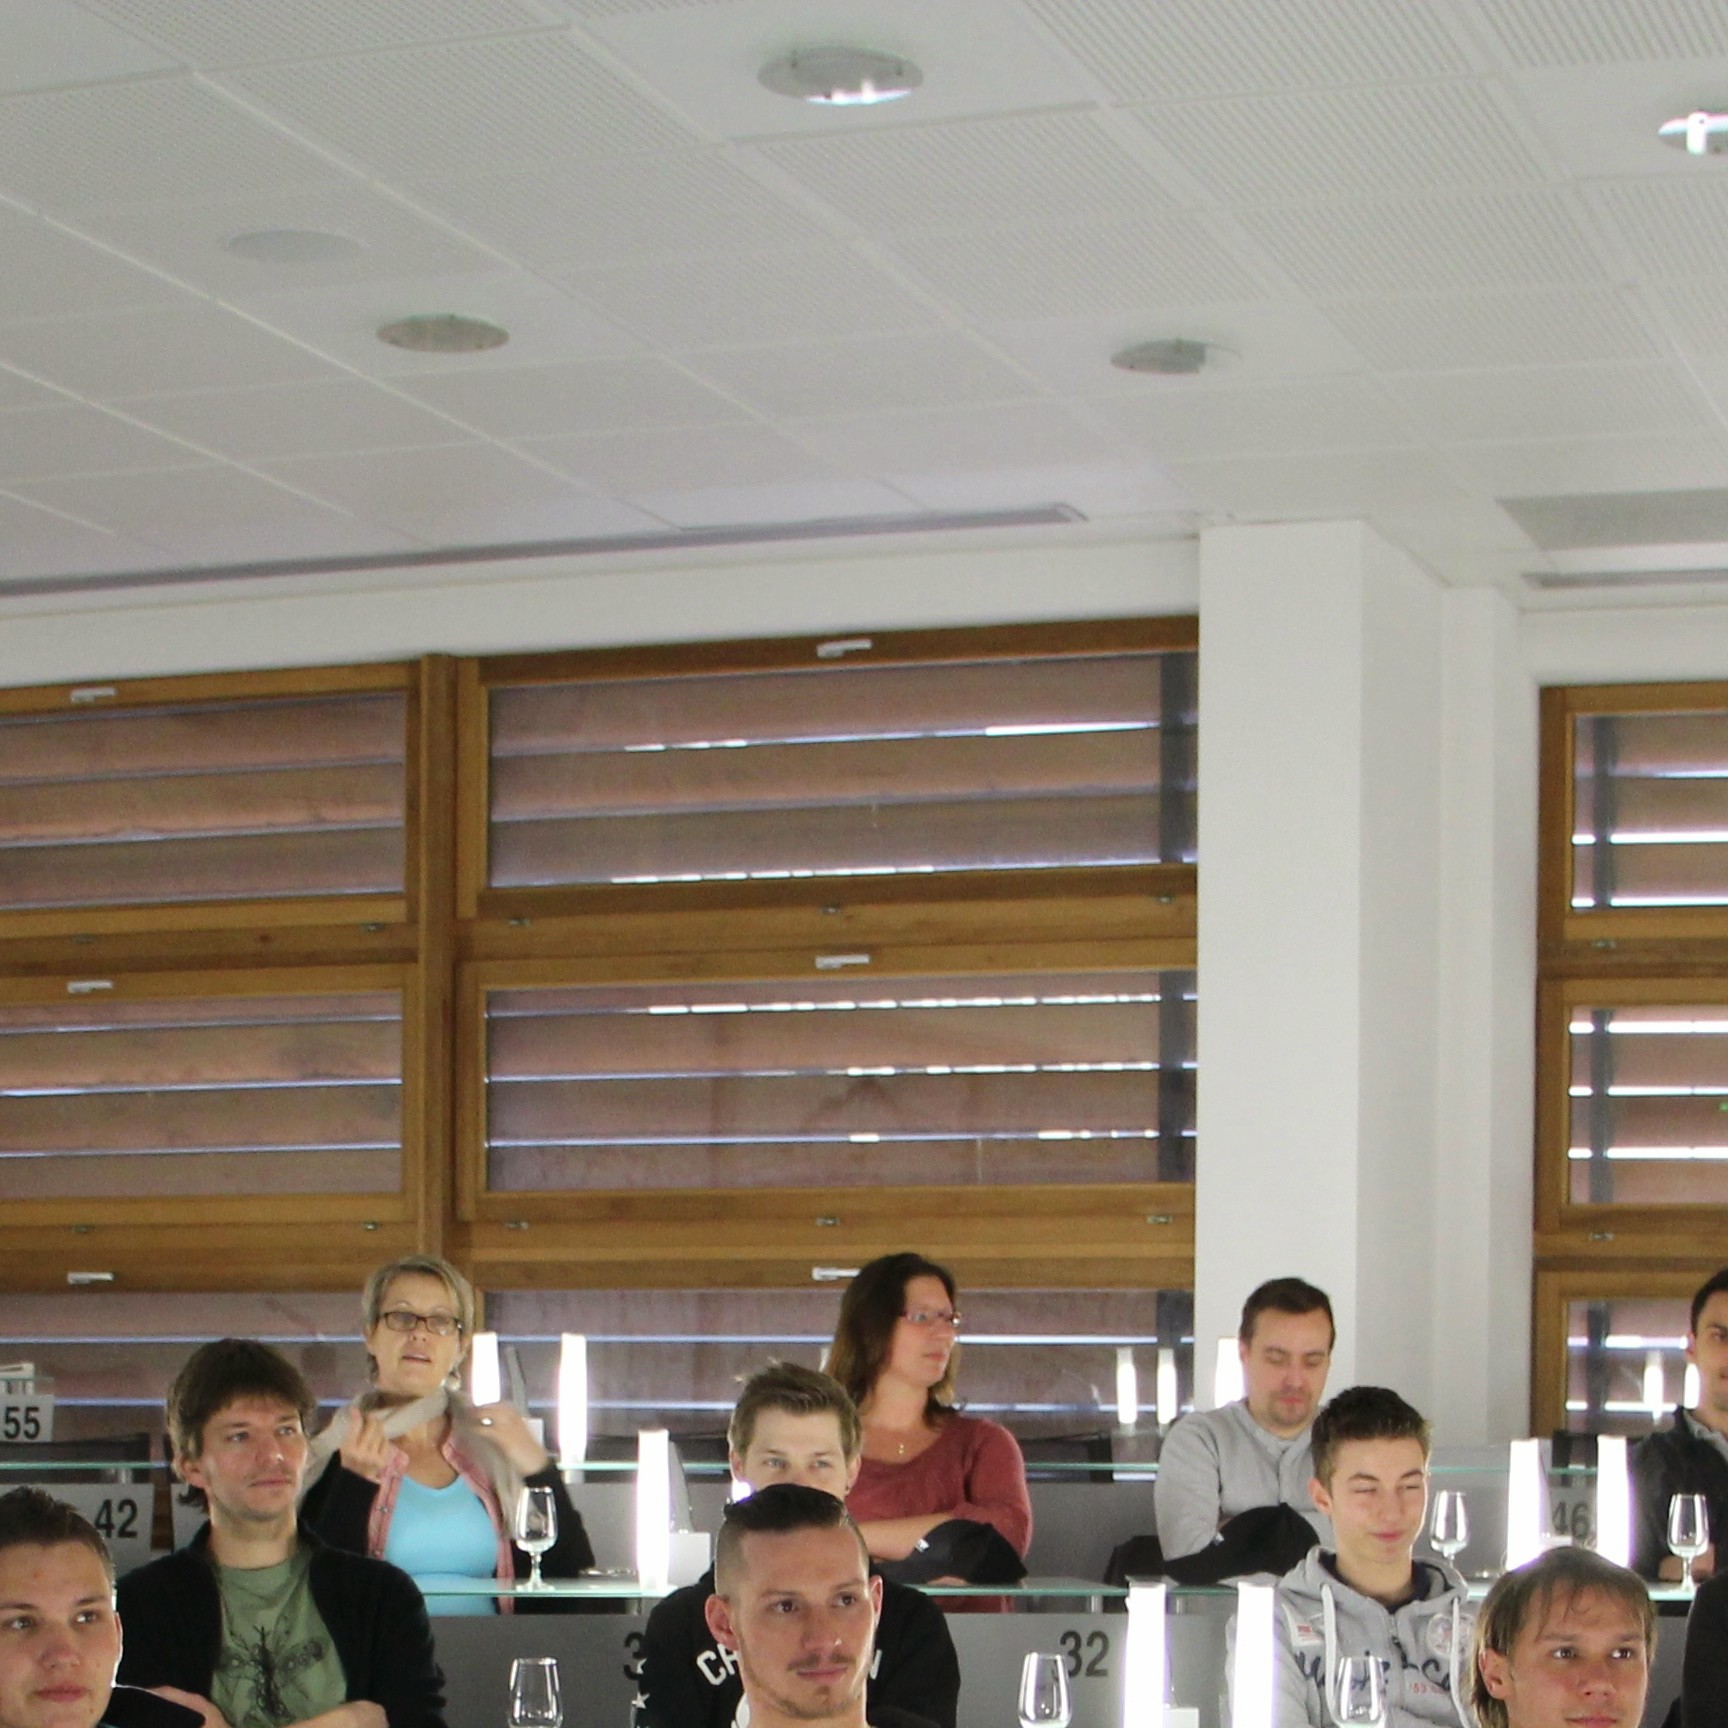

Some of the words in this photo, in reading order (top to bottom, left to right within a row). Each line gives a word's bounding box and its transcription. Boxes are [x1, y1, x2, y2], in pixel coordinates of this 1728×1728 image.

[3, 1406, 41, 1441] 55
[95, 1498, 139, 1538] 42
[1553, 1502, 1591, 1540] 46
[1059, 1630, 1109, 1678] 32
